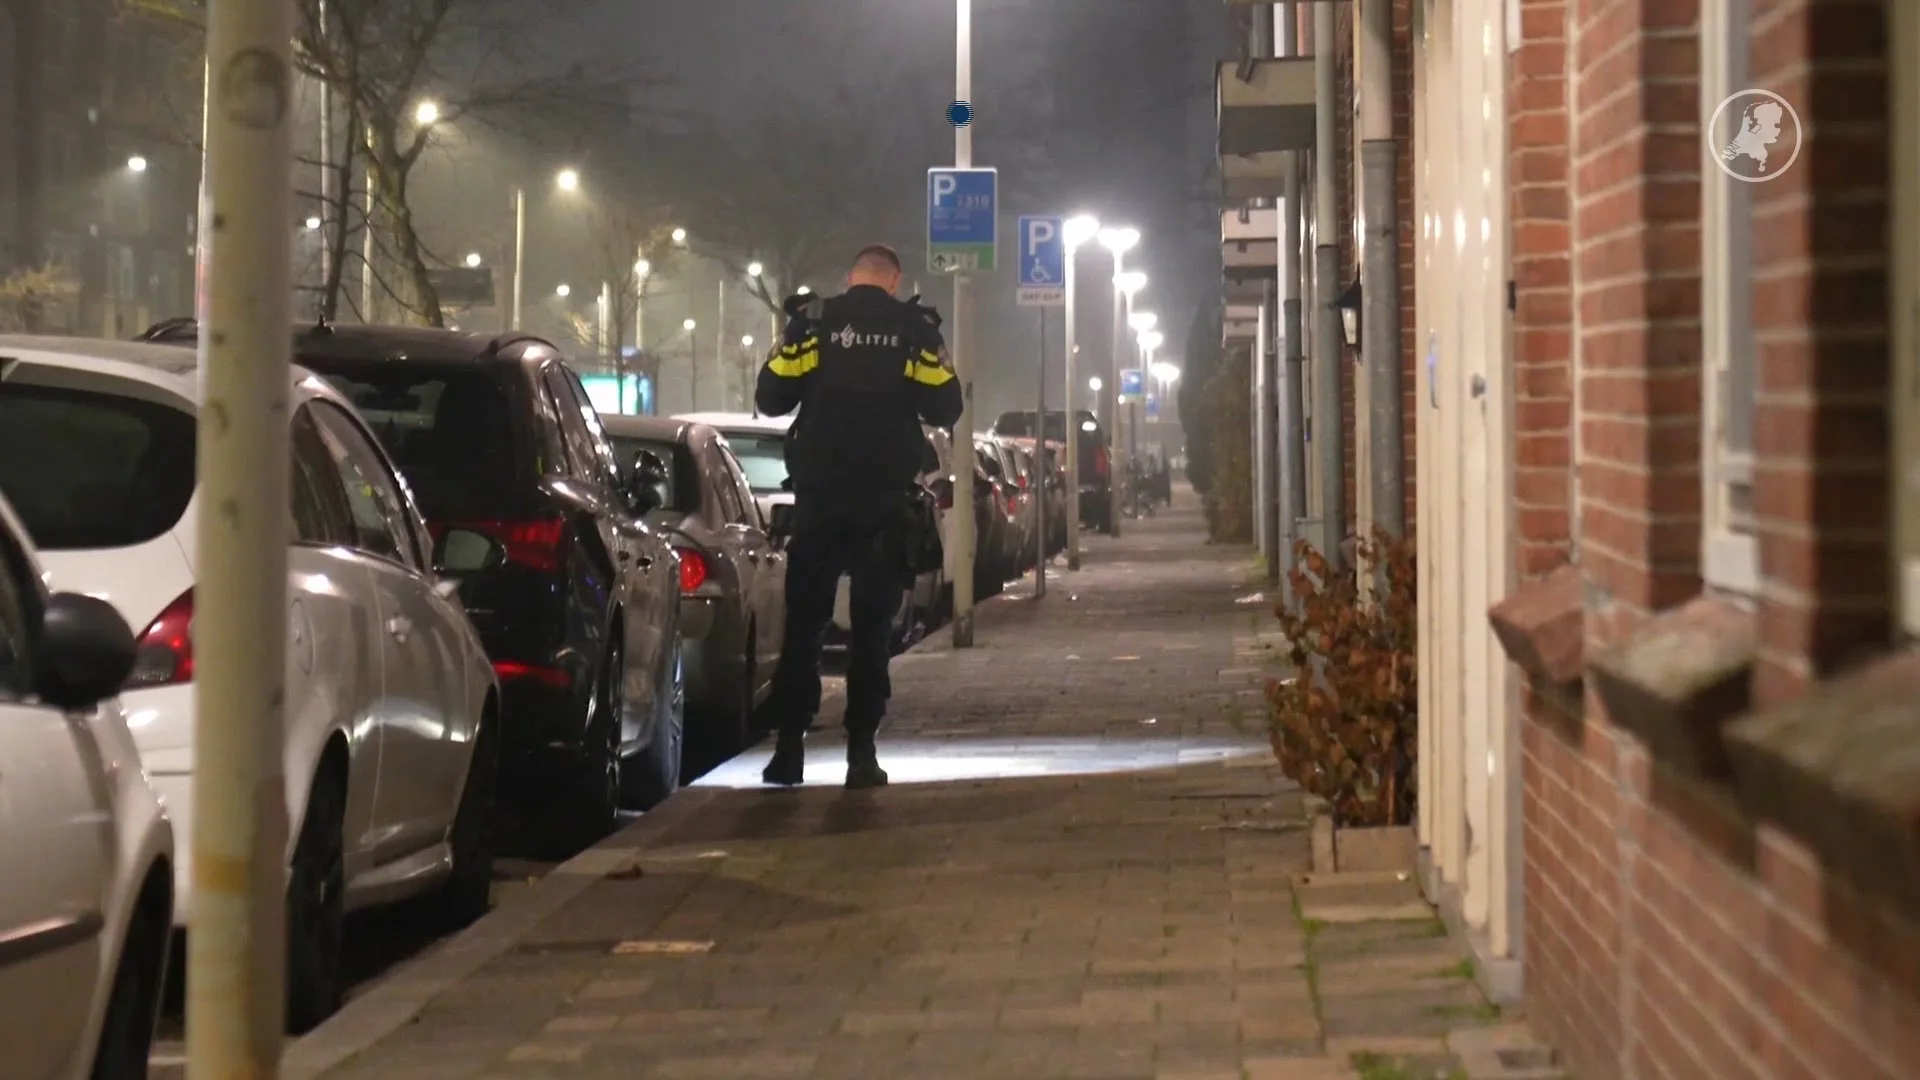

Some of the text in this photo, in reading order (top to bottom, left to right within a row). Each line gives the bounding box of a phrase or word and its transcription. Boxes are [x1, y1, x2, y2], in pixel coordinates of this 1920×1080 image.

[933, 174, 956, 206] P
[1029, 221, 1054, 256] P
[831, 325, 899, 348] POLITIE
